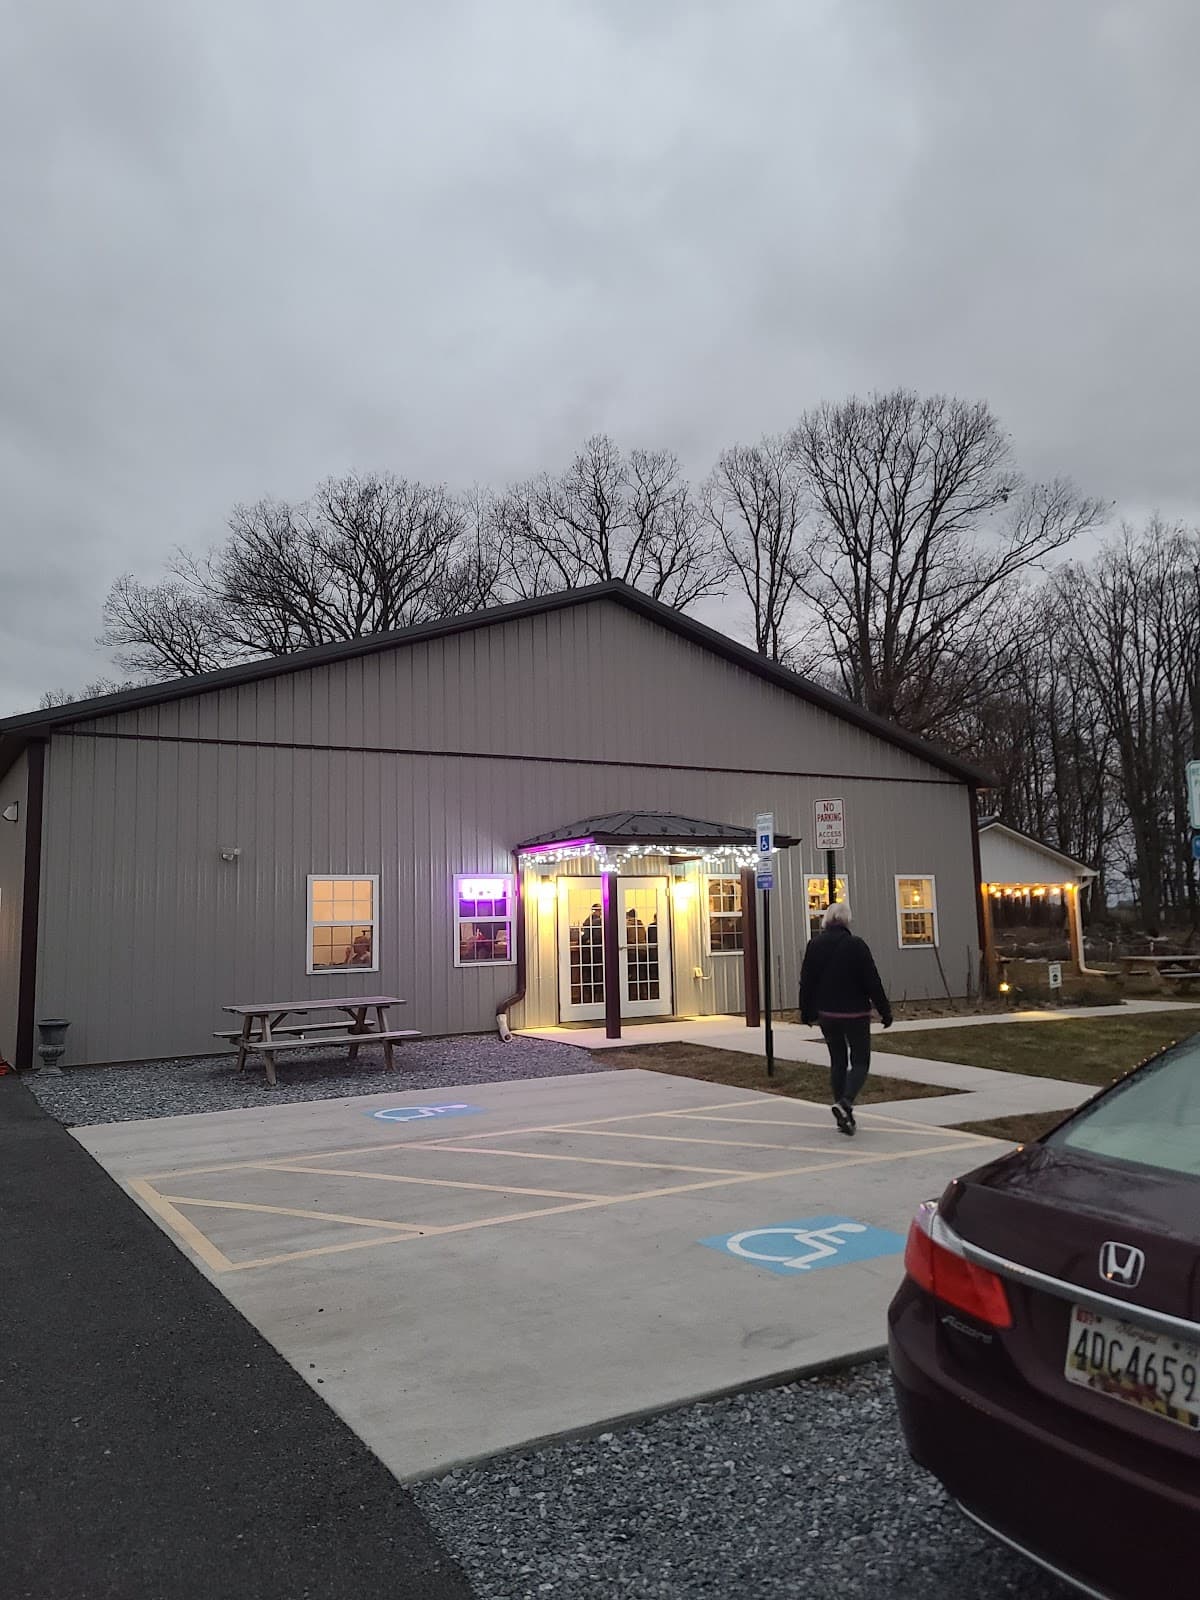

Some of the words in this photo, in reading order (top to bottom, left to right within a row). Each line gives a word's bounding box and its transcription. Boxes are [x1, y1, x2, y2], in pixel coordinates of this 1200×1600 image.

[823, 802, 835, 812] NO
[817, 813, 841, 822] PARKING
[1074, 1327, 1197, 1403] 4DC4659
